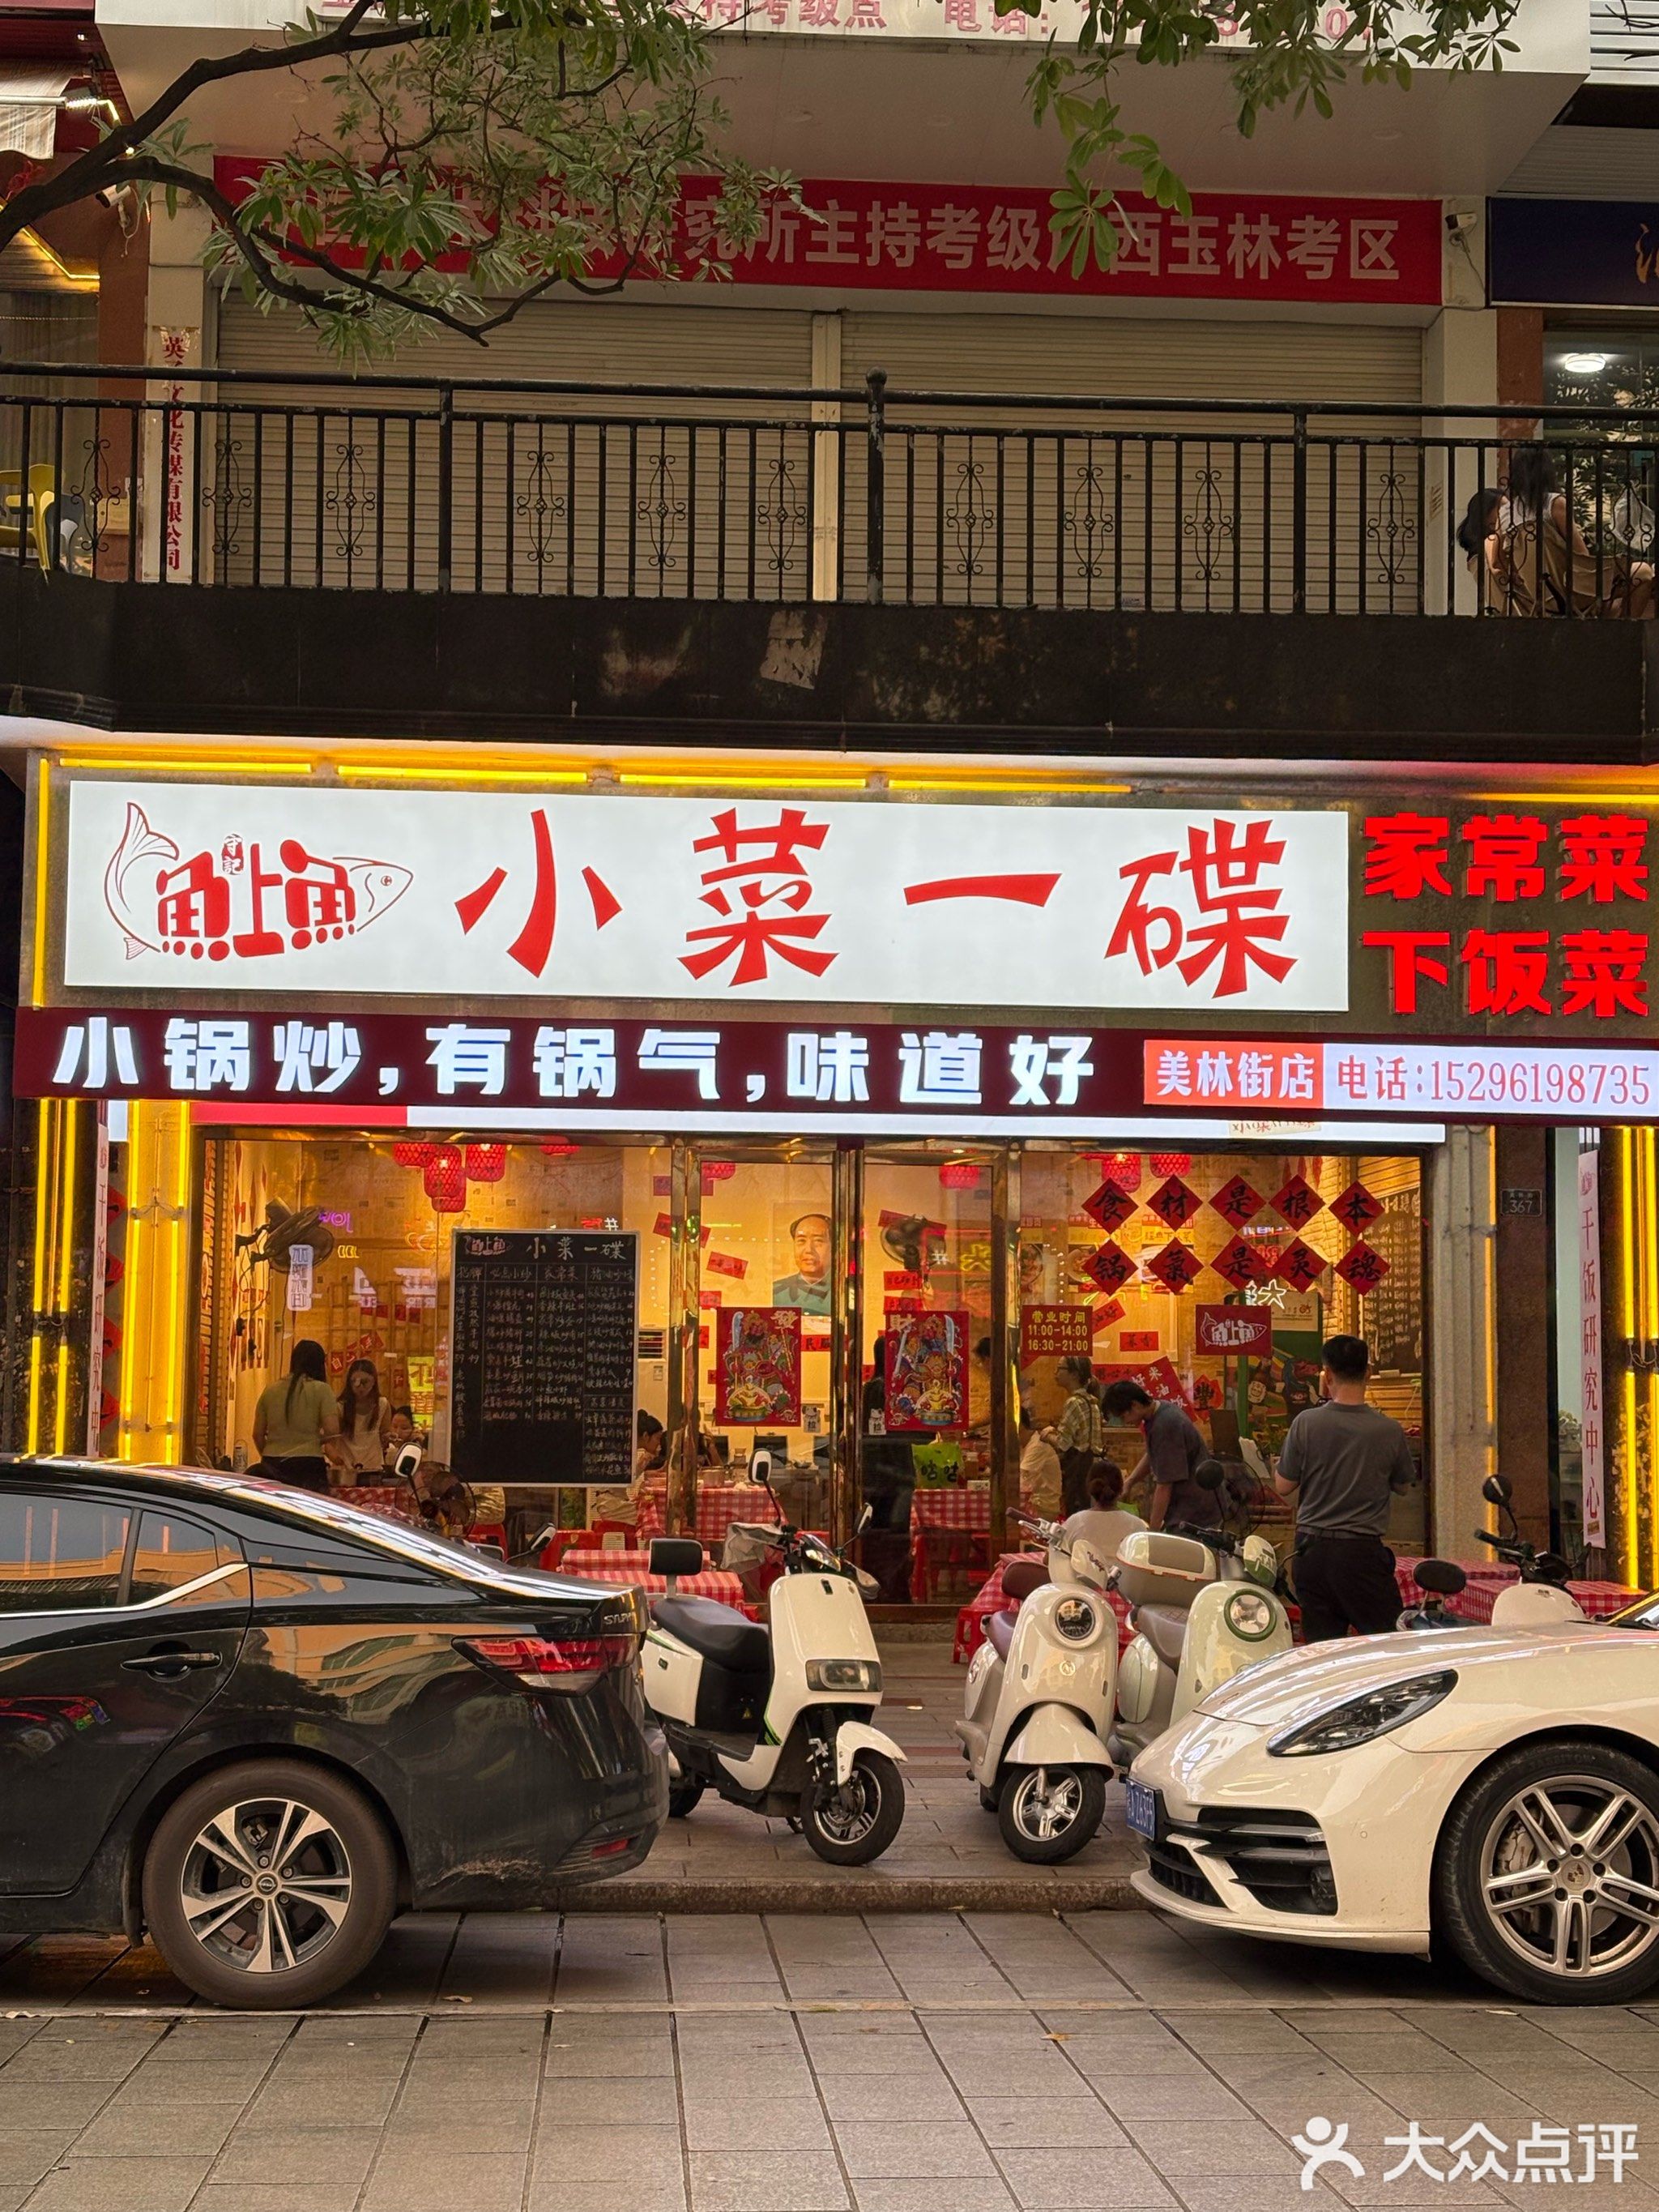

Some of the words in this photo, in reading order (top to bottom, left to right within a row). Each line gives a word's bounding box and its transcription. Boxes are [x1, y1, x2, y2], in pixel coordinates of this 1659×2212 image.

[1363, 812, 1648, 903] 家常菜
[455, 808, 1299, 998] 小菜一碟
[1362, 928, 1648, 1018] 下饭菜
[1156, 1049, 1316, 1100] 美林街店
[1510, 1200, 1532, 1213] 367
[1031, 1309, 1086, 1324] 营业时间
[1582, 1209, 1601, 1520] 干饭研究中心
